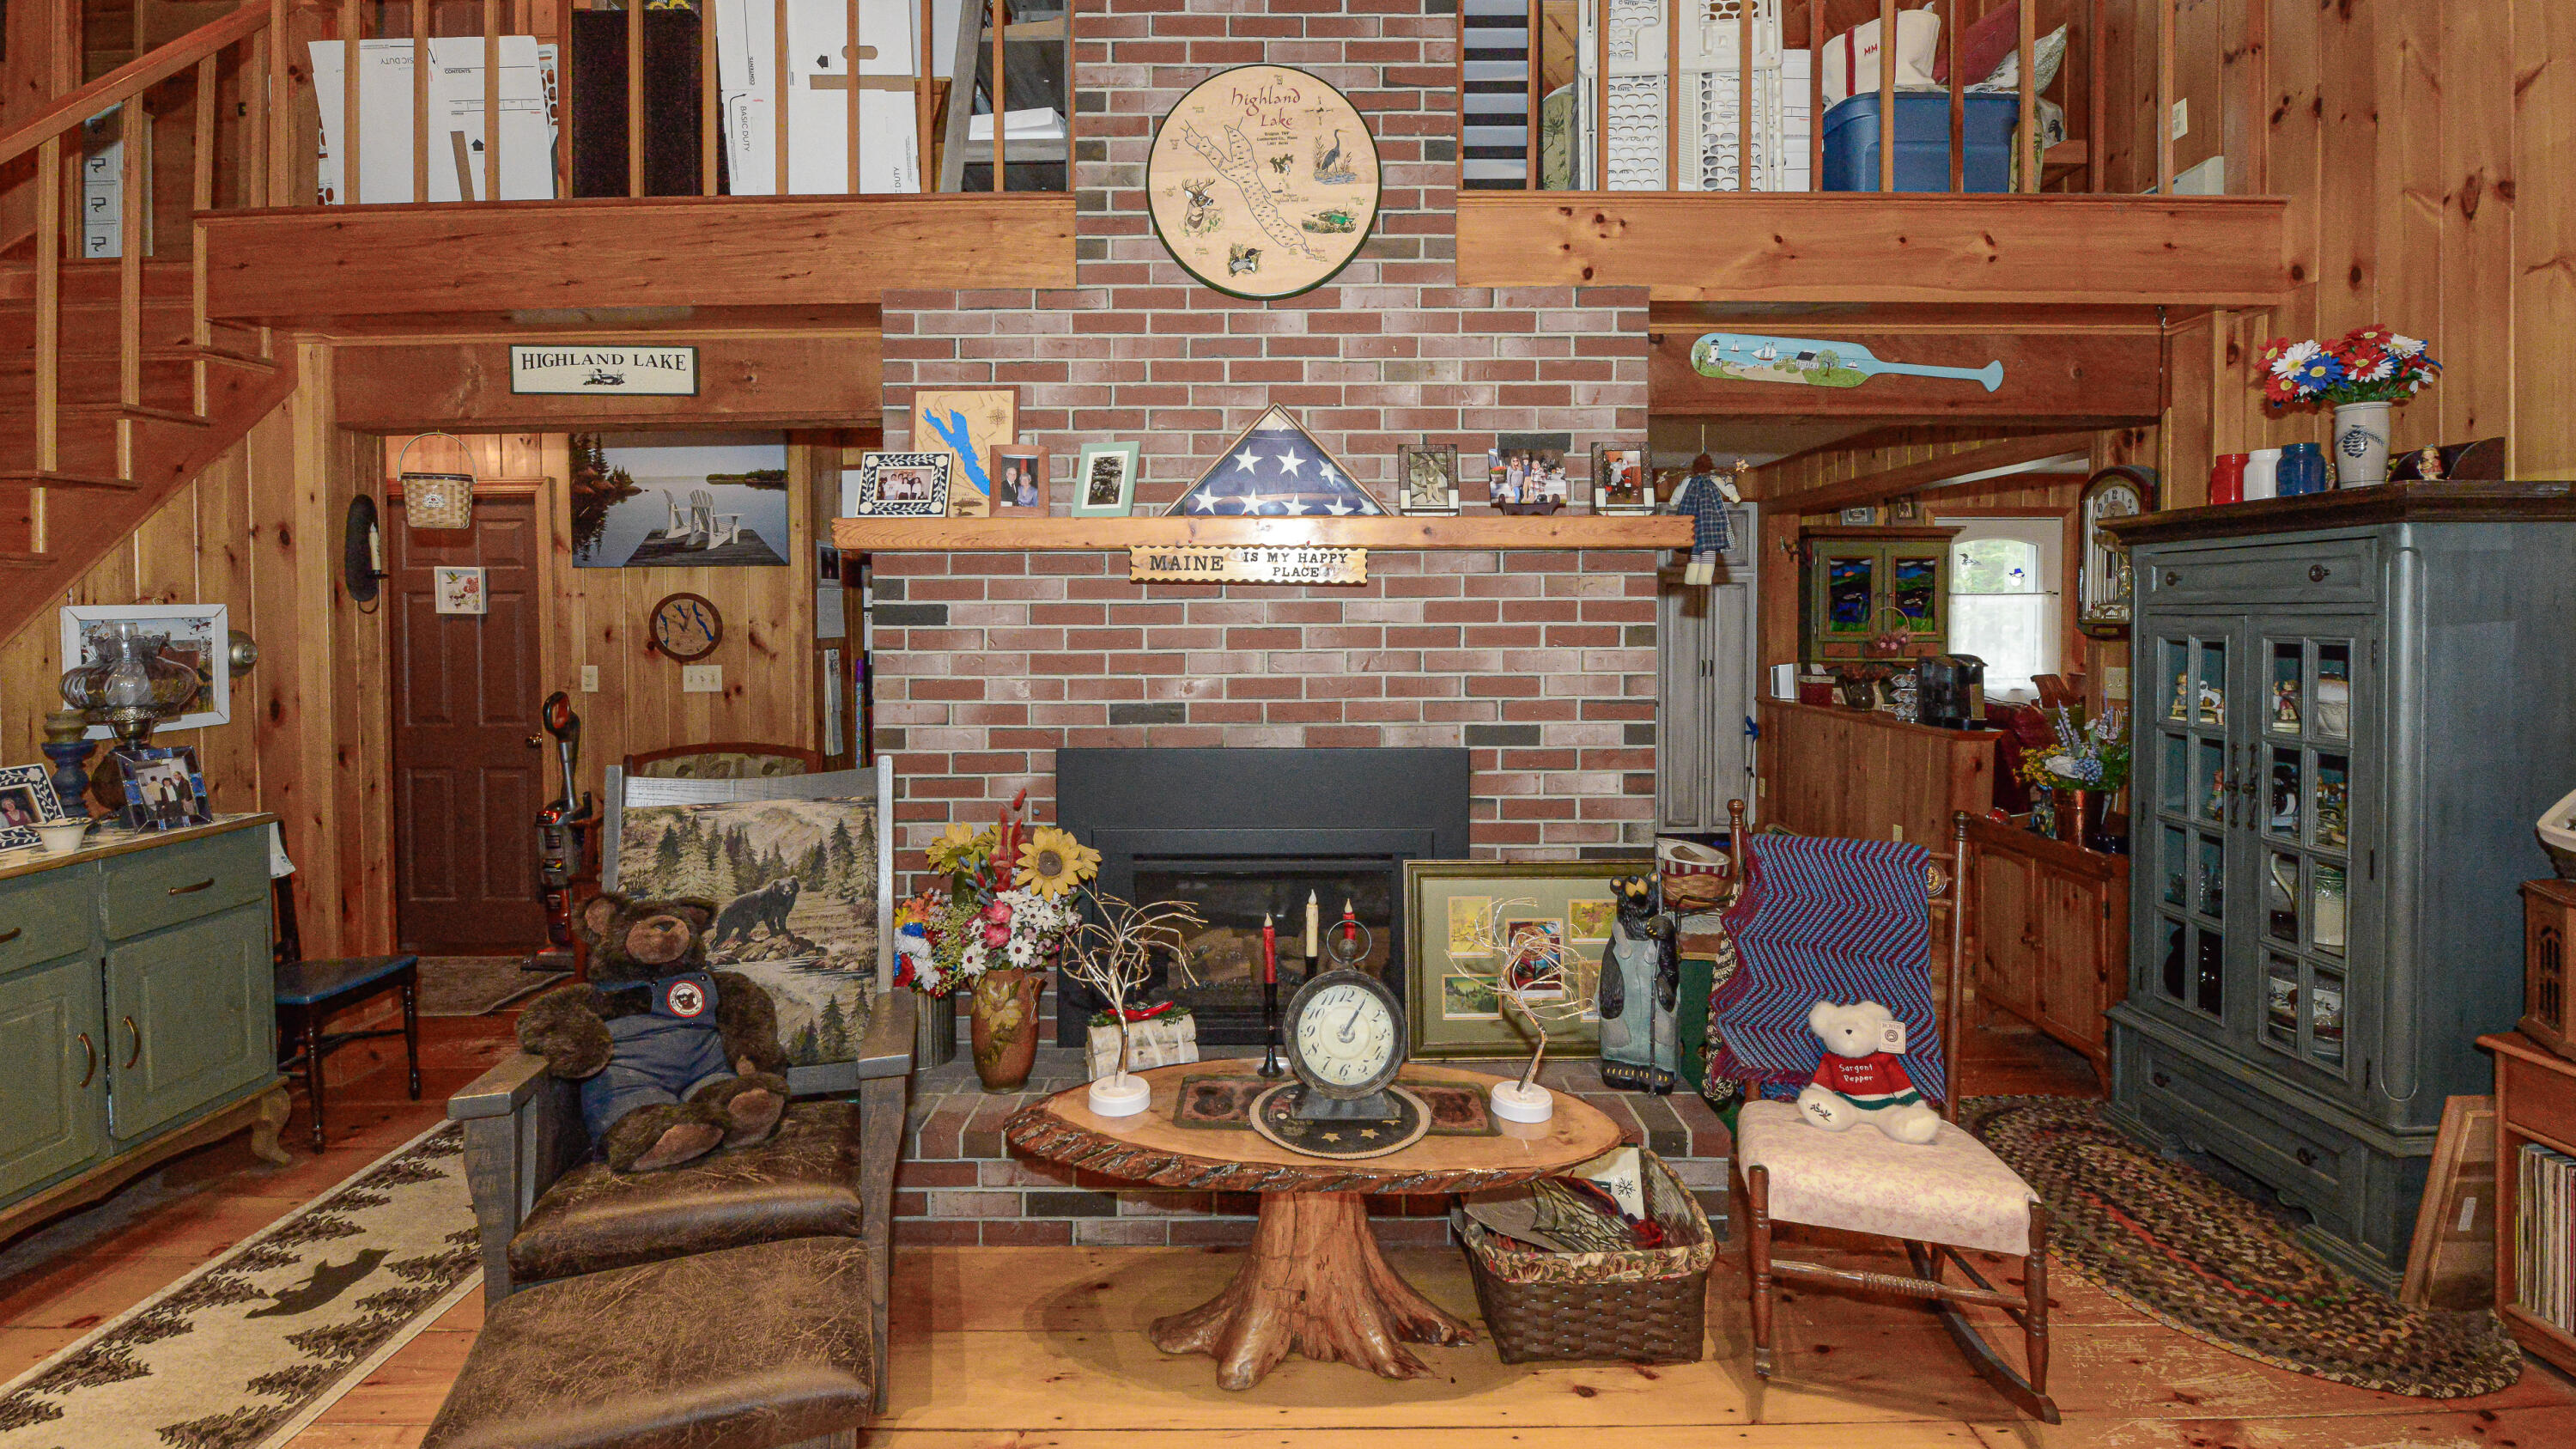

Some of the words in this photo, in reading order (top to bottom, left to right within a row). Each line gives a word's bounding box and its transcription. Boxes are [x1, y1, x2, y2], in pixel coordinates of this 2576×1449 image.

[740, 106, 749, 129] BASIC
[1261, 107, 1293, 131] Lake
[742, 131, 750, 152] DUTY
[893, 166, 902, 188] DUTY
[521, 353, 625, 371] HIGHLAND
[633, 353, 687, 372] LAKE
[1149, 555, 1224, 571] MAINE
[1243, 551, 1259, 563] IS
[1267, 552, 1291, 563] MY
[1297, 553, 1349, 563] HAPPY
[1272, 566, 1320, 577] PLACE
[1321, 993, 1336, 1006] 11
[1340, 989, 1355, 1003] 12
[1307, 1008, 1325, 1020] 10
[1370, 1009, 1381, 1023] 2
[1306, 1024, 1315, 1038] 9
[1375, 1027, 1388, 1041] 3
[1308, 1042, 1320, 1055] 8
[1323, 1055, 1332, 1071] 7
[1339, 1063, 1351, 1077] 6
[1358, 1059, 1370, 1074] 5
[1843, 1075, 1874, 1083] Pepper
